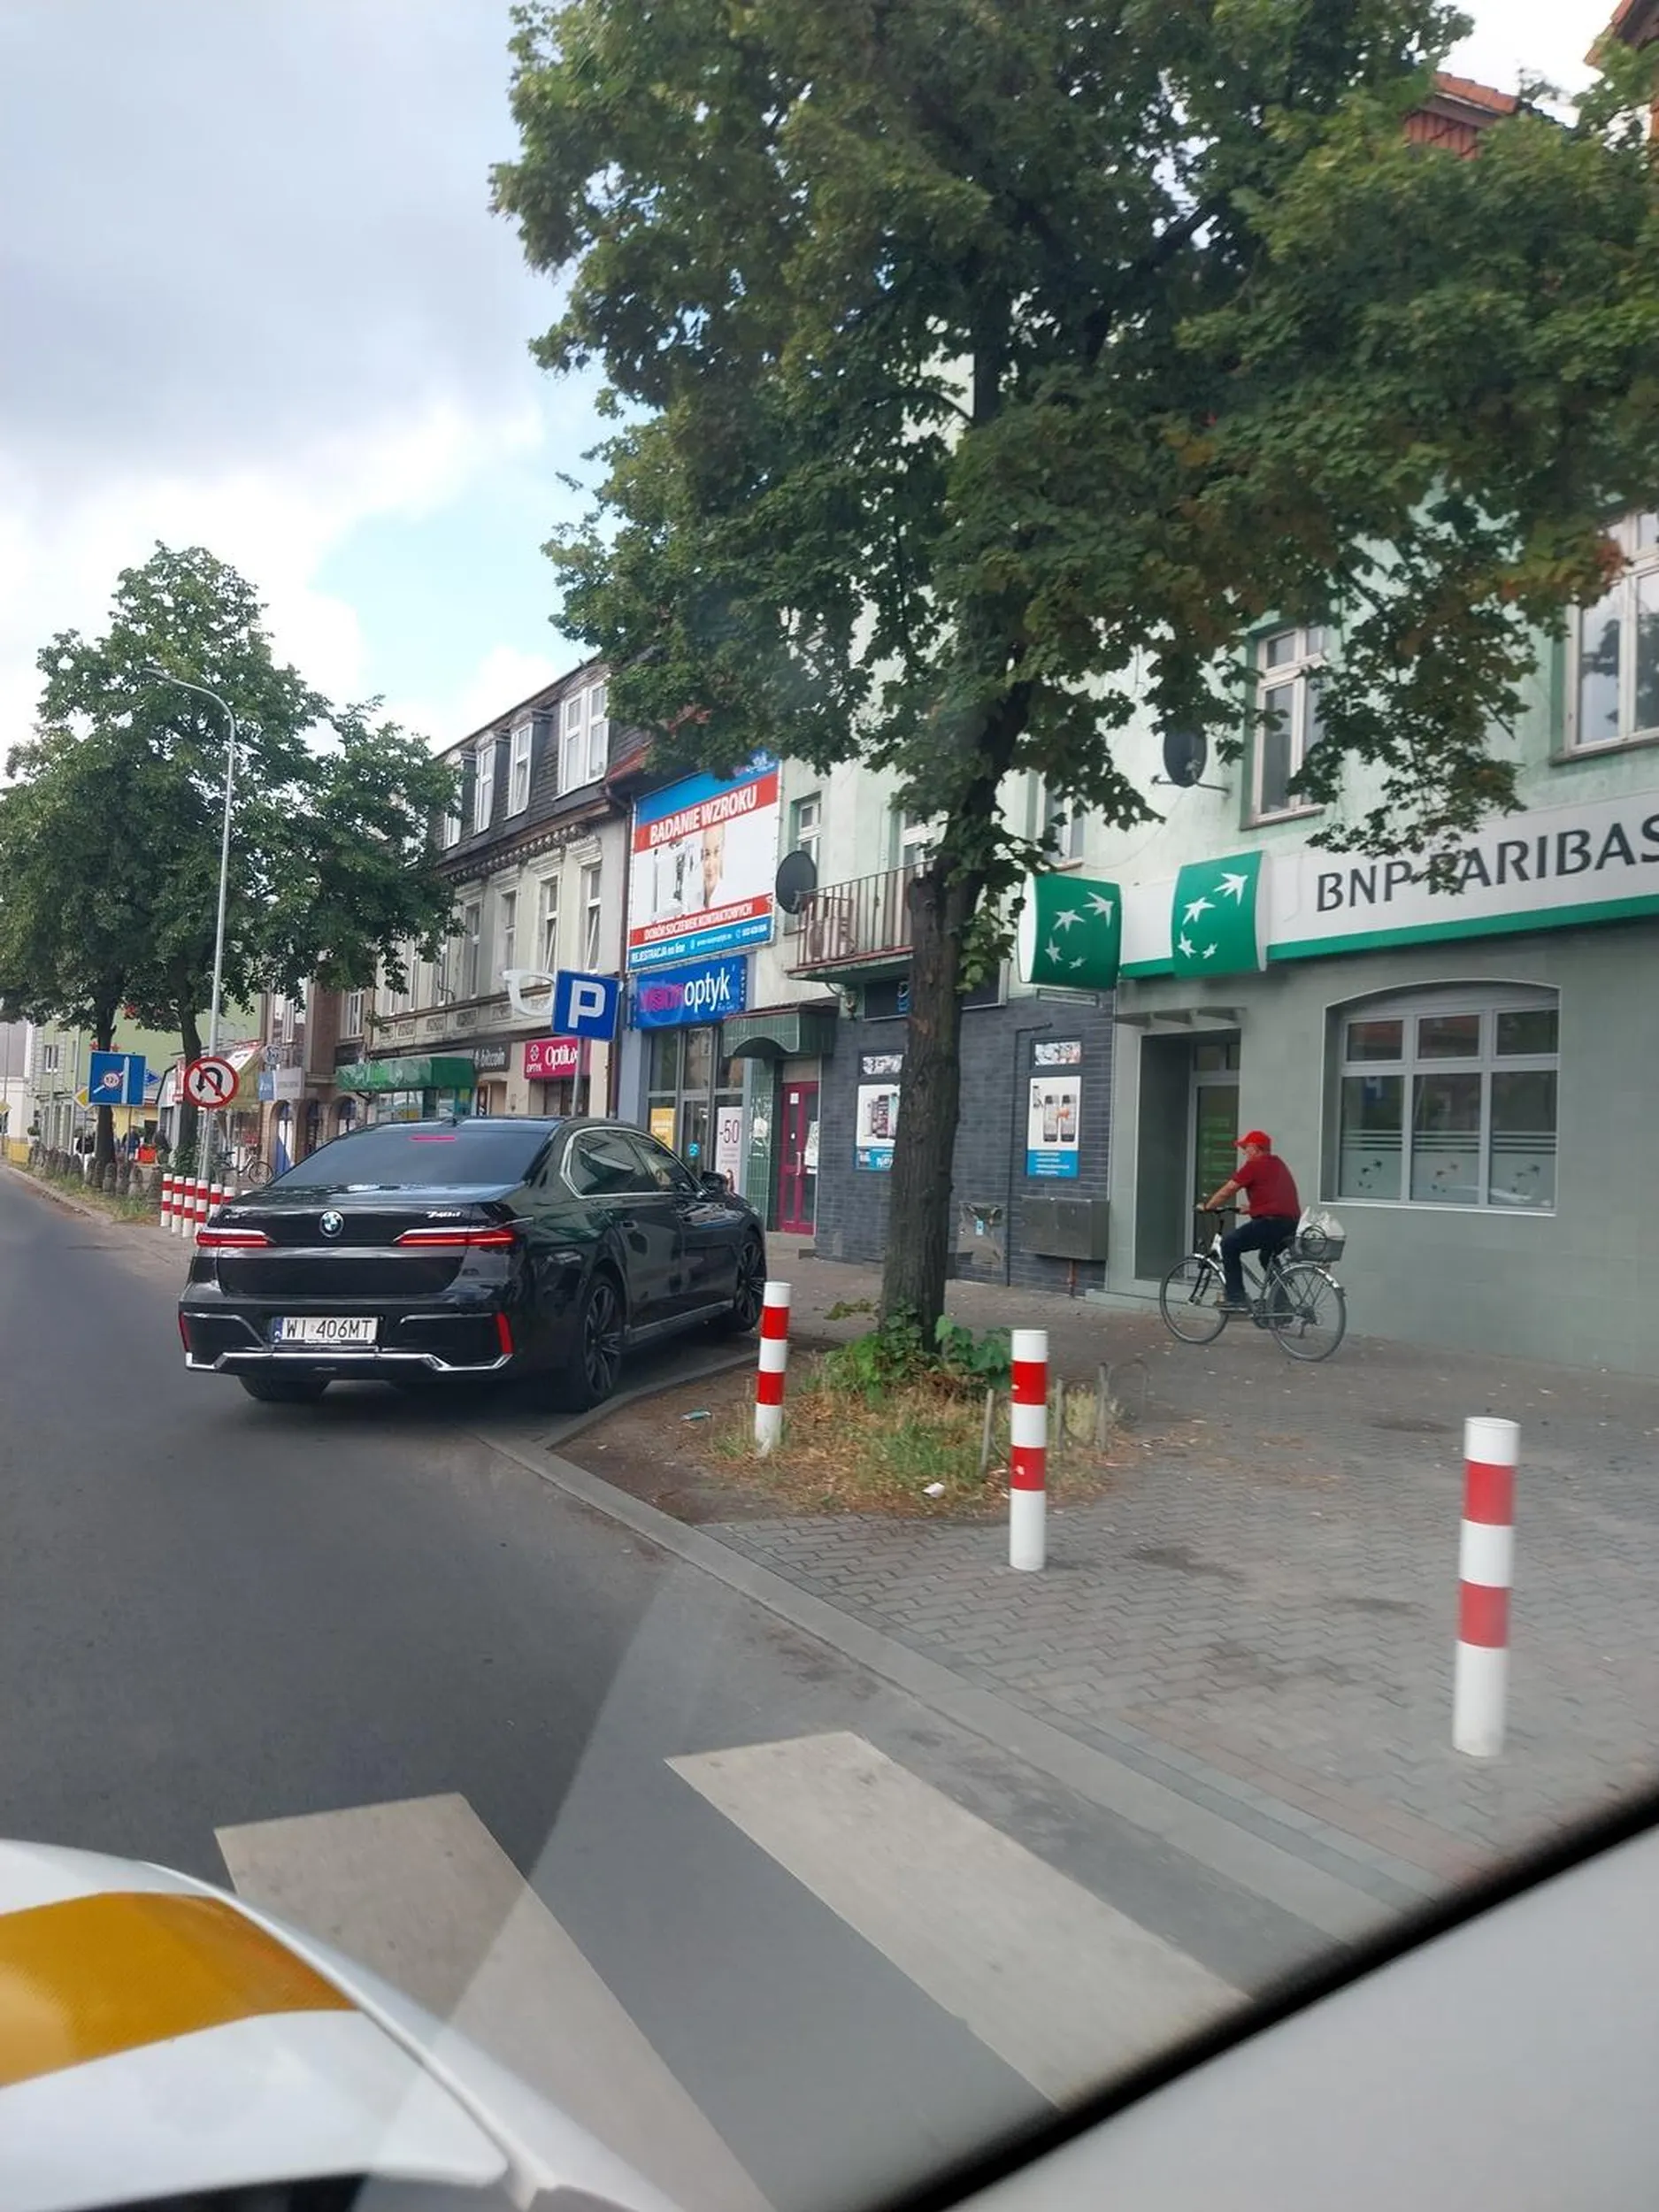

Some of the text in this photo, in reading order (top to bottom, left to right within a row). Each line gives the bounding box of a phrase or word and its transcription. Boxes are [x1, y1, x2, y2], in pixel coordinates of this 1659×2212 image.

[649, 784, 758, 846] BADANIE WZROKU
[1317, 859, 1412, 912] BNP
[567, 979, 606, 1029] P
[684, 967, 731, 1013] optyk
[286, 1319, 307, 1338] WI
[316, 1319, 373, 1339] 406MT
